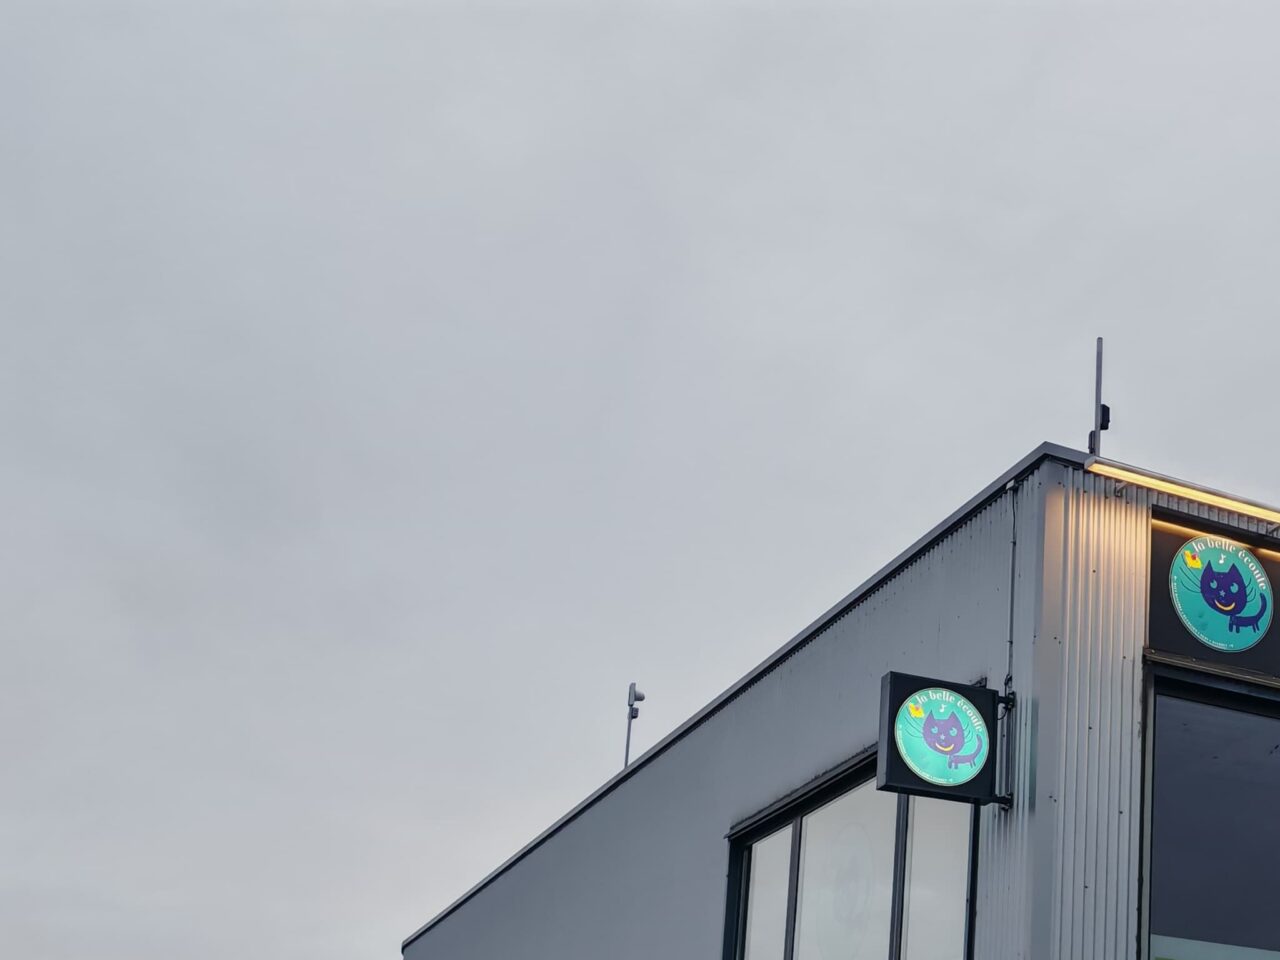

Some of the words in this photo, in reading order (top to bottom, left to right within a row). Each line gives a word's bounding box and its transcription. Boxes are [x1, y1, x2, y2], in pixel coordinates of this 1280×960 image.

[1192, 540, 1207, 553] la
[1206, 537, 1236, 553] belle
[1238, 549, 1267, 590] écoute
